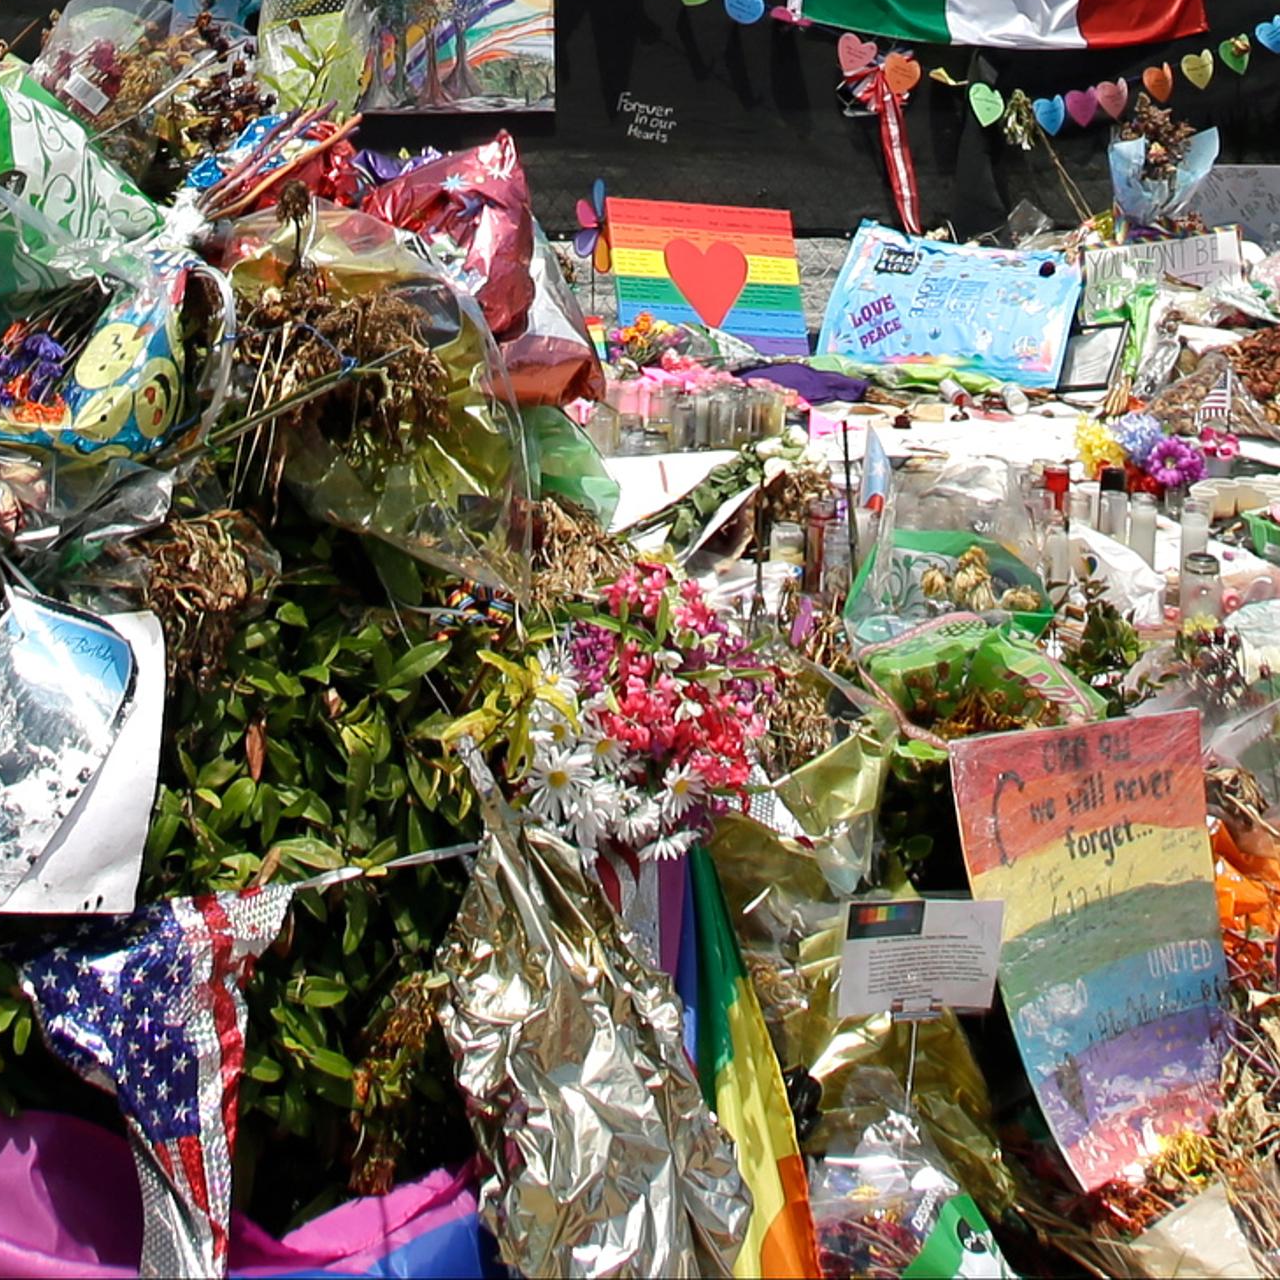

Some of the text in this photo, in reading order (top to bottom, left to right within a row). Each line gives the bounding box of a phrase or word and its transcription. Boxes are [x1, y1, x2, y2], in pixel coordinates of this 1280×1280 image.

[616, 91, 674, 117] Forever
[627, 124, 668, 143] Hearts
[1195, 237, 1220, 266] BE
[850, 294, 896, 328] LOVE
[859, 316, 903, 350] PEACE
[1066, 771, 1105, 816] will
[1114, 769, 1174, 804] never
[1147, 938, 1214, 978] UNITED
